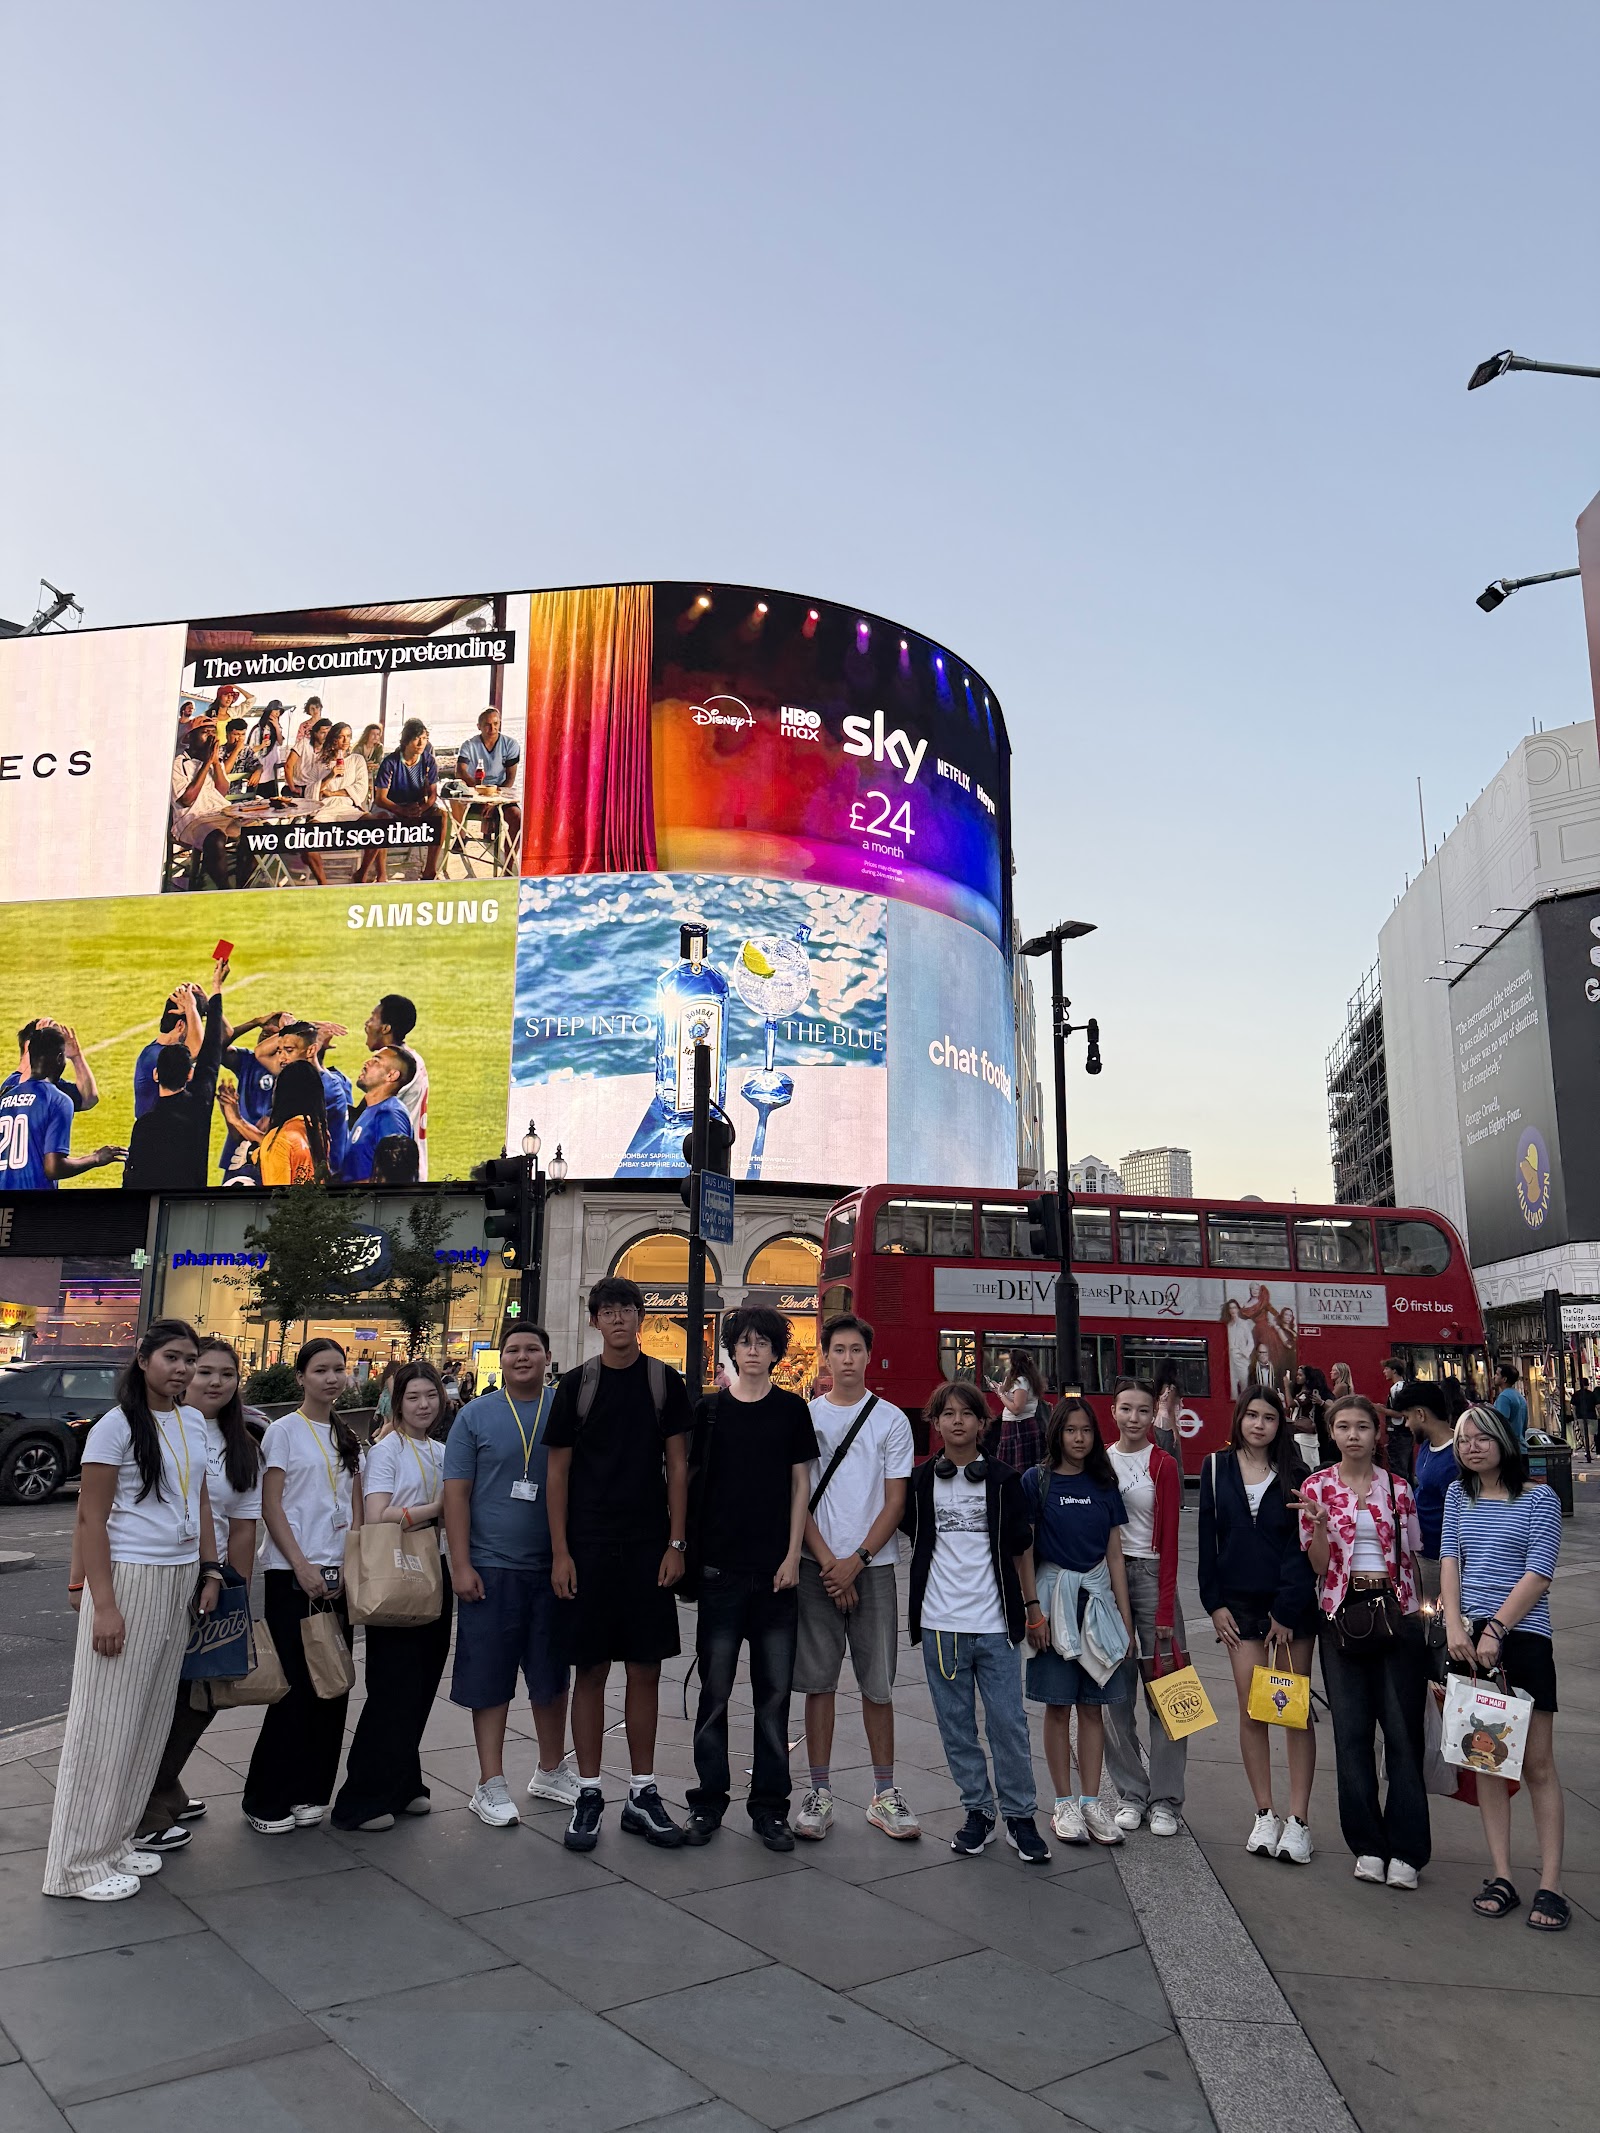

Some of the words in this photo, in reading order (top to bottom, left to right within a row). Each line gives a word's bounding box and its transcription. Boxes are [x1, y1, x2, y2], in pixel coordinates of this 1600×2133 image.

[203, 657, 242, 679] The
[246, 652, 305, 676] whole
[307, 645, 391, 671] country
[391, 637, 507, 669] pretending
[689, 695, 756, 732] Disney+
[781, 706, 821, 728] HBO
[781, 725, 819, 742] max
[842, 709, 928, 784] sky
[937, 758, 970, 793] NETFLIX
[849, 791, 915, 844] £24
[247, 834, 278, 851] we
[284, 826, 344, 849] didn't
[346, 828, 384, 846] see
[387, 822, 435, 844] that:
[862, 840, 869, 850] a
[871, 842, 905, 859] month
[347, 899, 499, 929] SAMSUNG
[1467, 1000, 1494, 1029] instrument
[1504, 969, 1533, 998] telescreen,
[685, 1008, 714, 1021] BOMBAY
[525, 1016, 585, 1038] STEP
[591, 1015, 652, 1036] INTO
[782, 1020, 826, 1043] THE
[832, 1024, 884, 1051] BLUE
[1464, 1038, 1473, 1051] was
[1489, 1010, 1502, 1032] could
[1503, 1007, 1509, 1020] be
[1461, 1060, 1469, 1074] but
[1470, 1054, 1481, 1068] there
[1482, 1045, 1491, 1058] was
[1491, 1041, 1498, 1052] no
[1498, 1032, 1508, 1046] way
[1509, 1022, 1515, 1038] of
[1515, 1010, 1539, 1034] shutting
[929, 1035, 978, 1077] chat
[1466, 1110, 1481, 1126] George
[1467, 1127, 1488, 1146] Nineteen
[705, 1175, 716, 1187] BUS
[717, 1179, 731, 1191] LANE
[1517, 1182, 1544, 1228] MULLVAD
[1541, 1172, 1550, 1210] VPN
[718, 1215, 732, 1227] BOTH
[172, 1249, 267, 1270] pharmacy
[435, 1246, 490, 1267] eauty
[643, 1293, 680, 1307] Lindt
[776, 1294, 813, 1308] Lindt
[973, 1283, 998, 1294] THE
[997, 1275, 1055, 1301] DEV
[1078, 1287, 1110, 1298] EARS
[1109, 1284, 1178, 1306] PRADA
[1157, 1283, 1184, 1315] 2
[1309, 1288, 1321, 1297] IN
[1323, 1288, 1372, 1299] CINEMAS
[1317, 1300, 1352, 1313] MAY
[1357, 1300, 1363, 1313] 1
[1410, 1300, 1433, 1312] first
[1434, 1301, 1454, 1313] bus
[185, 1608, 249, 1654] Boots
[1170, 1695, 1200, 1715] TWG
[1181, 1708, 1195, 1717] TEA
[1477, 1695, 1488, 1704] POP
[1489, 1698, 1505, 1709] MART
